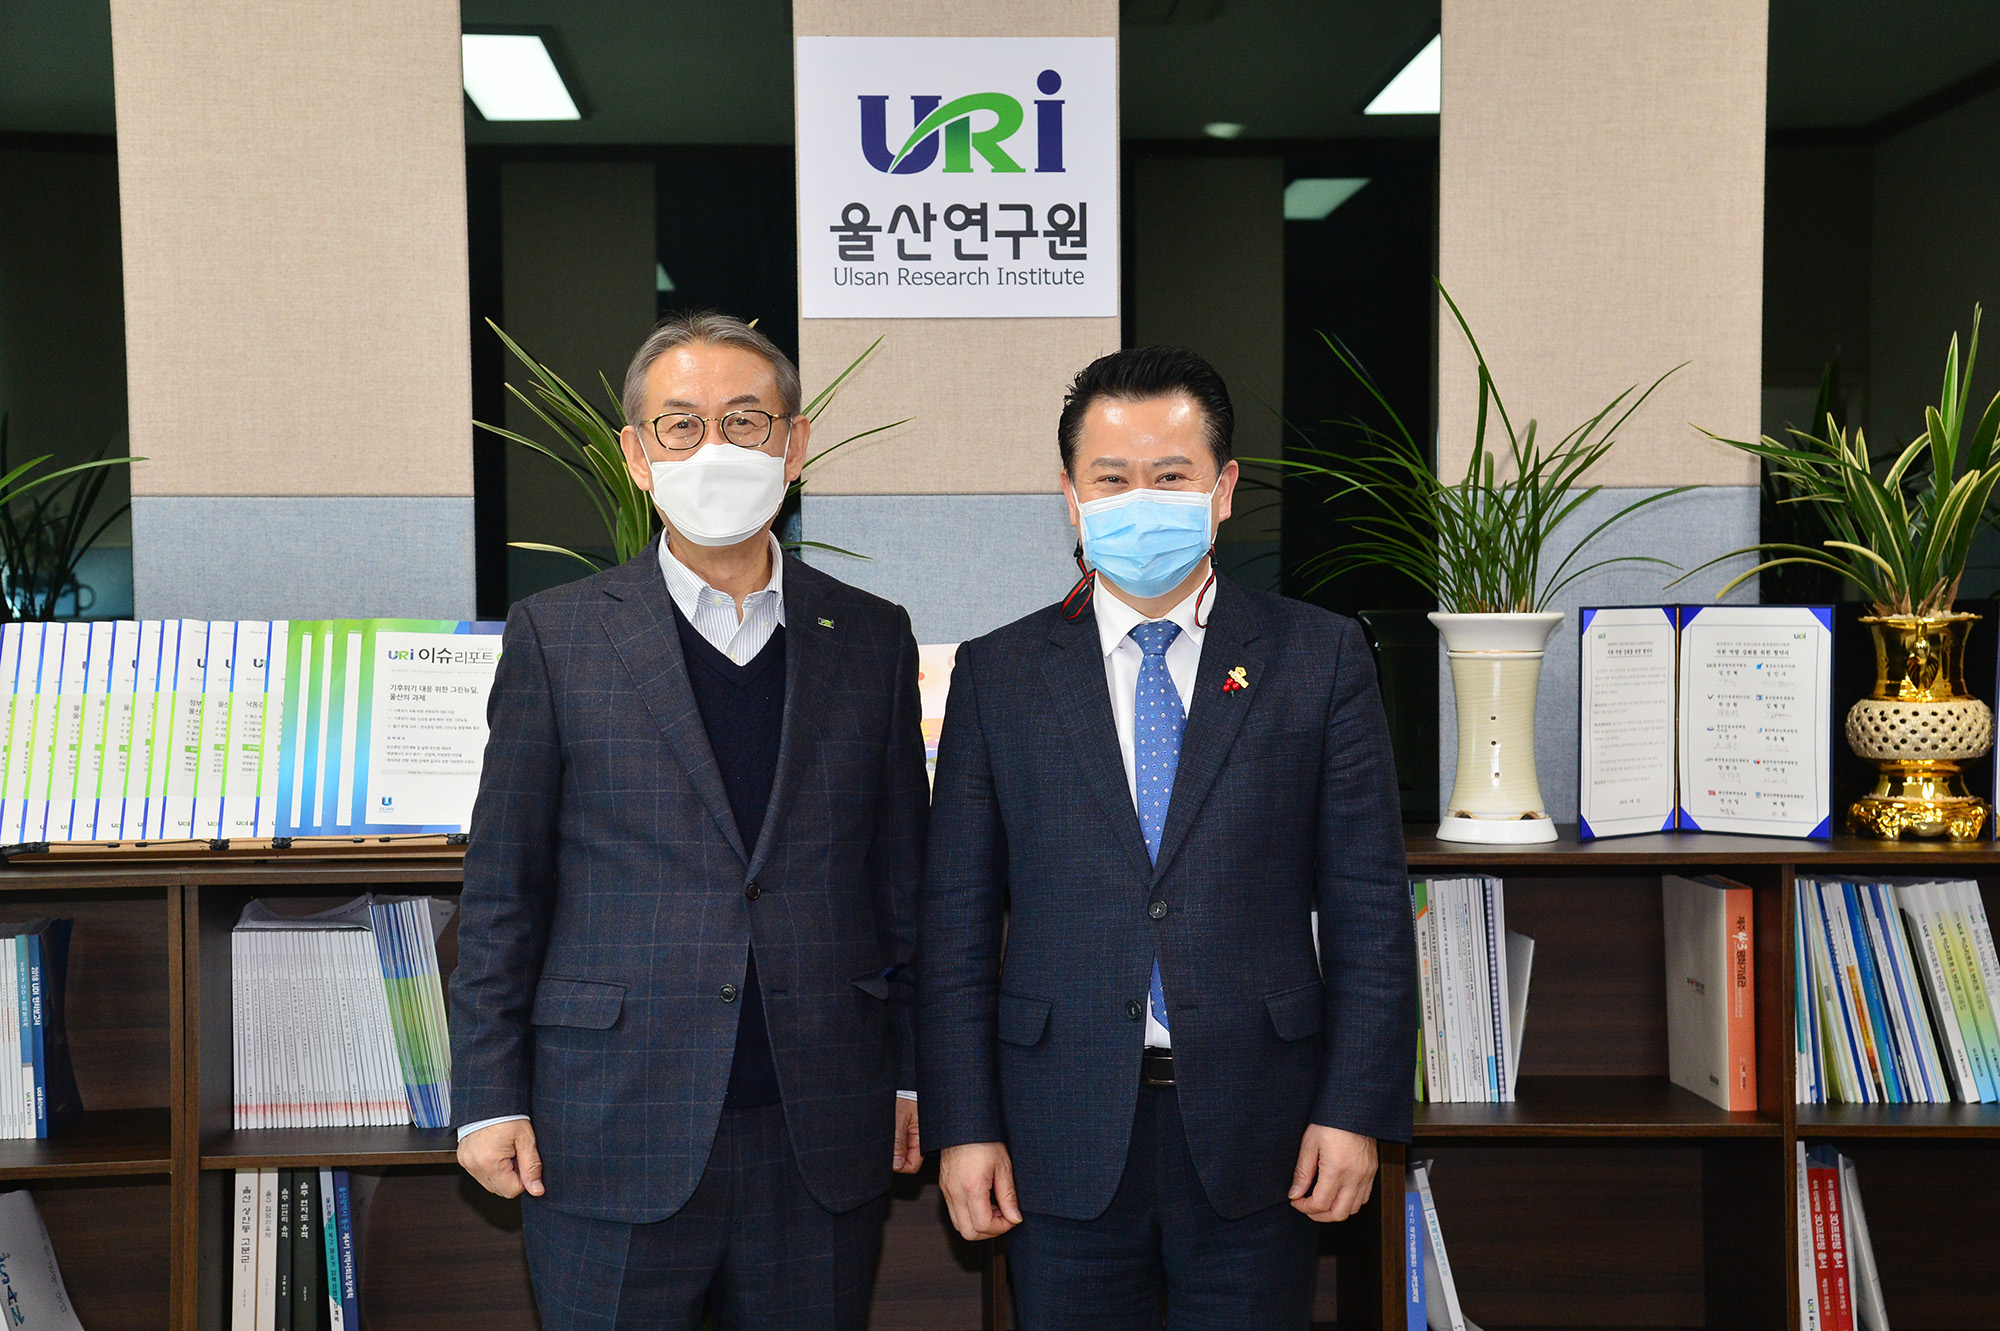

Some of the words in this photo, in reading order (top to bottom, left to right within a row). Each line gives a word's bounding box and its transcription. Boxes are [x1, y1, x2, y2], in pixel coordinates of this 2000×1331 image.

[830, 202, 1087, 262] 울산연구원
[834, 266, 888, 286] Ulsan
[897, 266, 989, 286] Research
[996, 266, 1084, 286] Institute
[418, 647, 494, 664] 이슈리포트
[389, 693, 410, 701] 울산의
[412, 694, 426, 702] 과제
[390, 684, 417, 692] 기후위기
[419, 684, 433, 692] 대응
[435, 685, 448, 694] 위한
[450, 686, 479, 694] 그린뉴딜,
[31, 966, 39, 982] 2018
[32, 996, 41, 1026] 연차보고서
[300, 1182, 308, 1197] 울주
[1812, 1179, 1818, 1190] 4차
[1828, 1179, 1834, 1189] 4차
[243, 1186, 251, 1203] 울산
[266, 1190, 272, 1203] 울주
[281, 1188, 289, 1201] 울주
[339, 1186, 348, 1216] 울산광역시
[1828, 1189, 1836, 1212] 산업혁명
[242, 1207, 251, 1233] 상안동
[281, 1225, 289, 1238] 유적
[301, 1224, 309, 1239] 유적
[1815, 1213, 1826, 1251] 3D프린팅
[1830, 1213, 1842, 1251] 3D프린팅
[343, 1232, 351, 1250] 제4기
[1818, 1252, 1828, 1269] 총서
[1833, 1252, 1844, 1269] 총서
[344, 1250, 354, 1299] 지역사회보장계획
